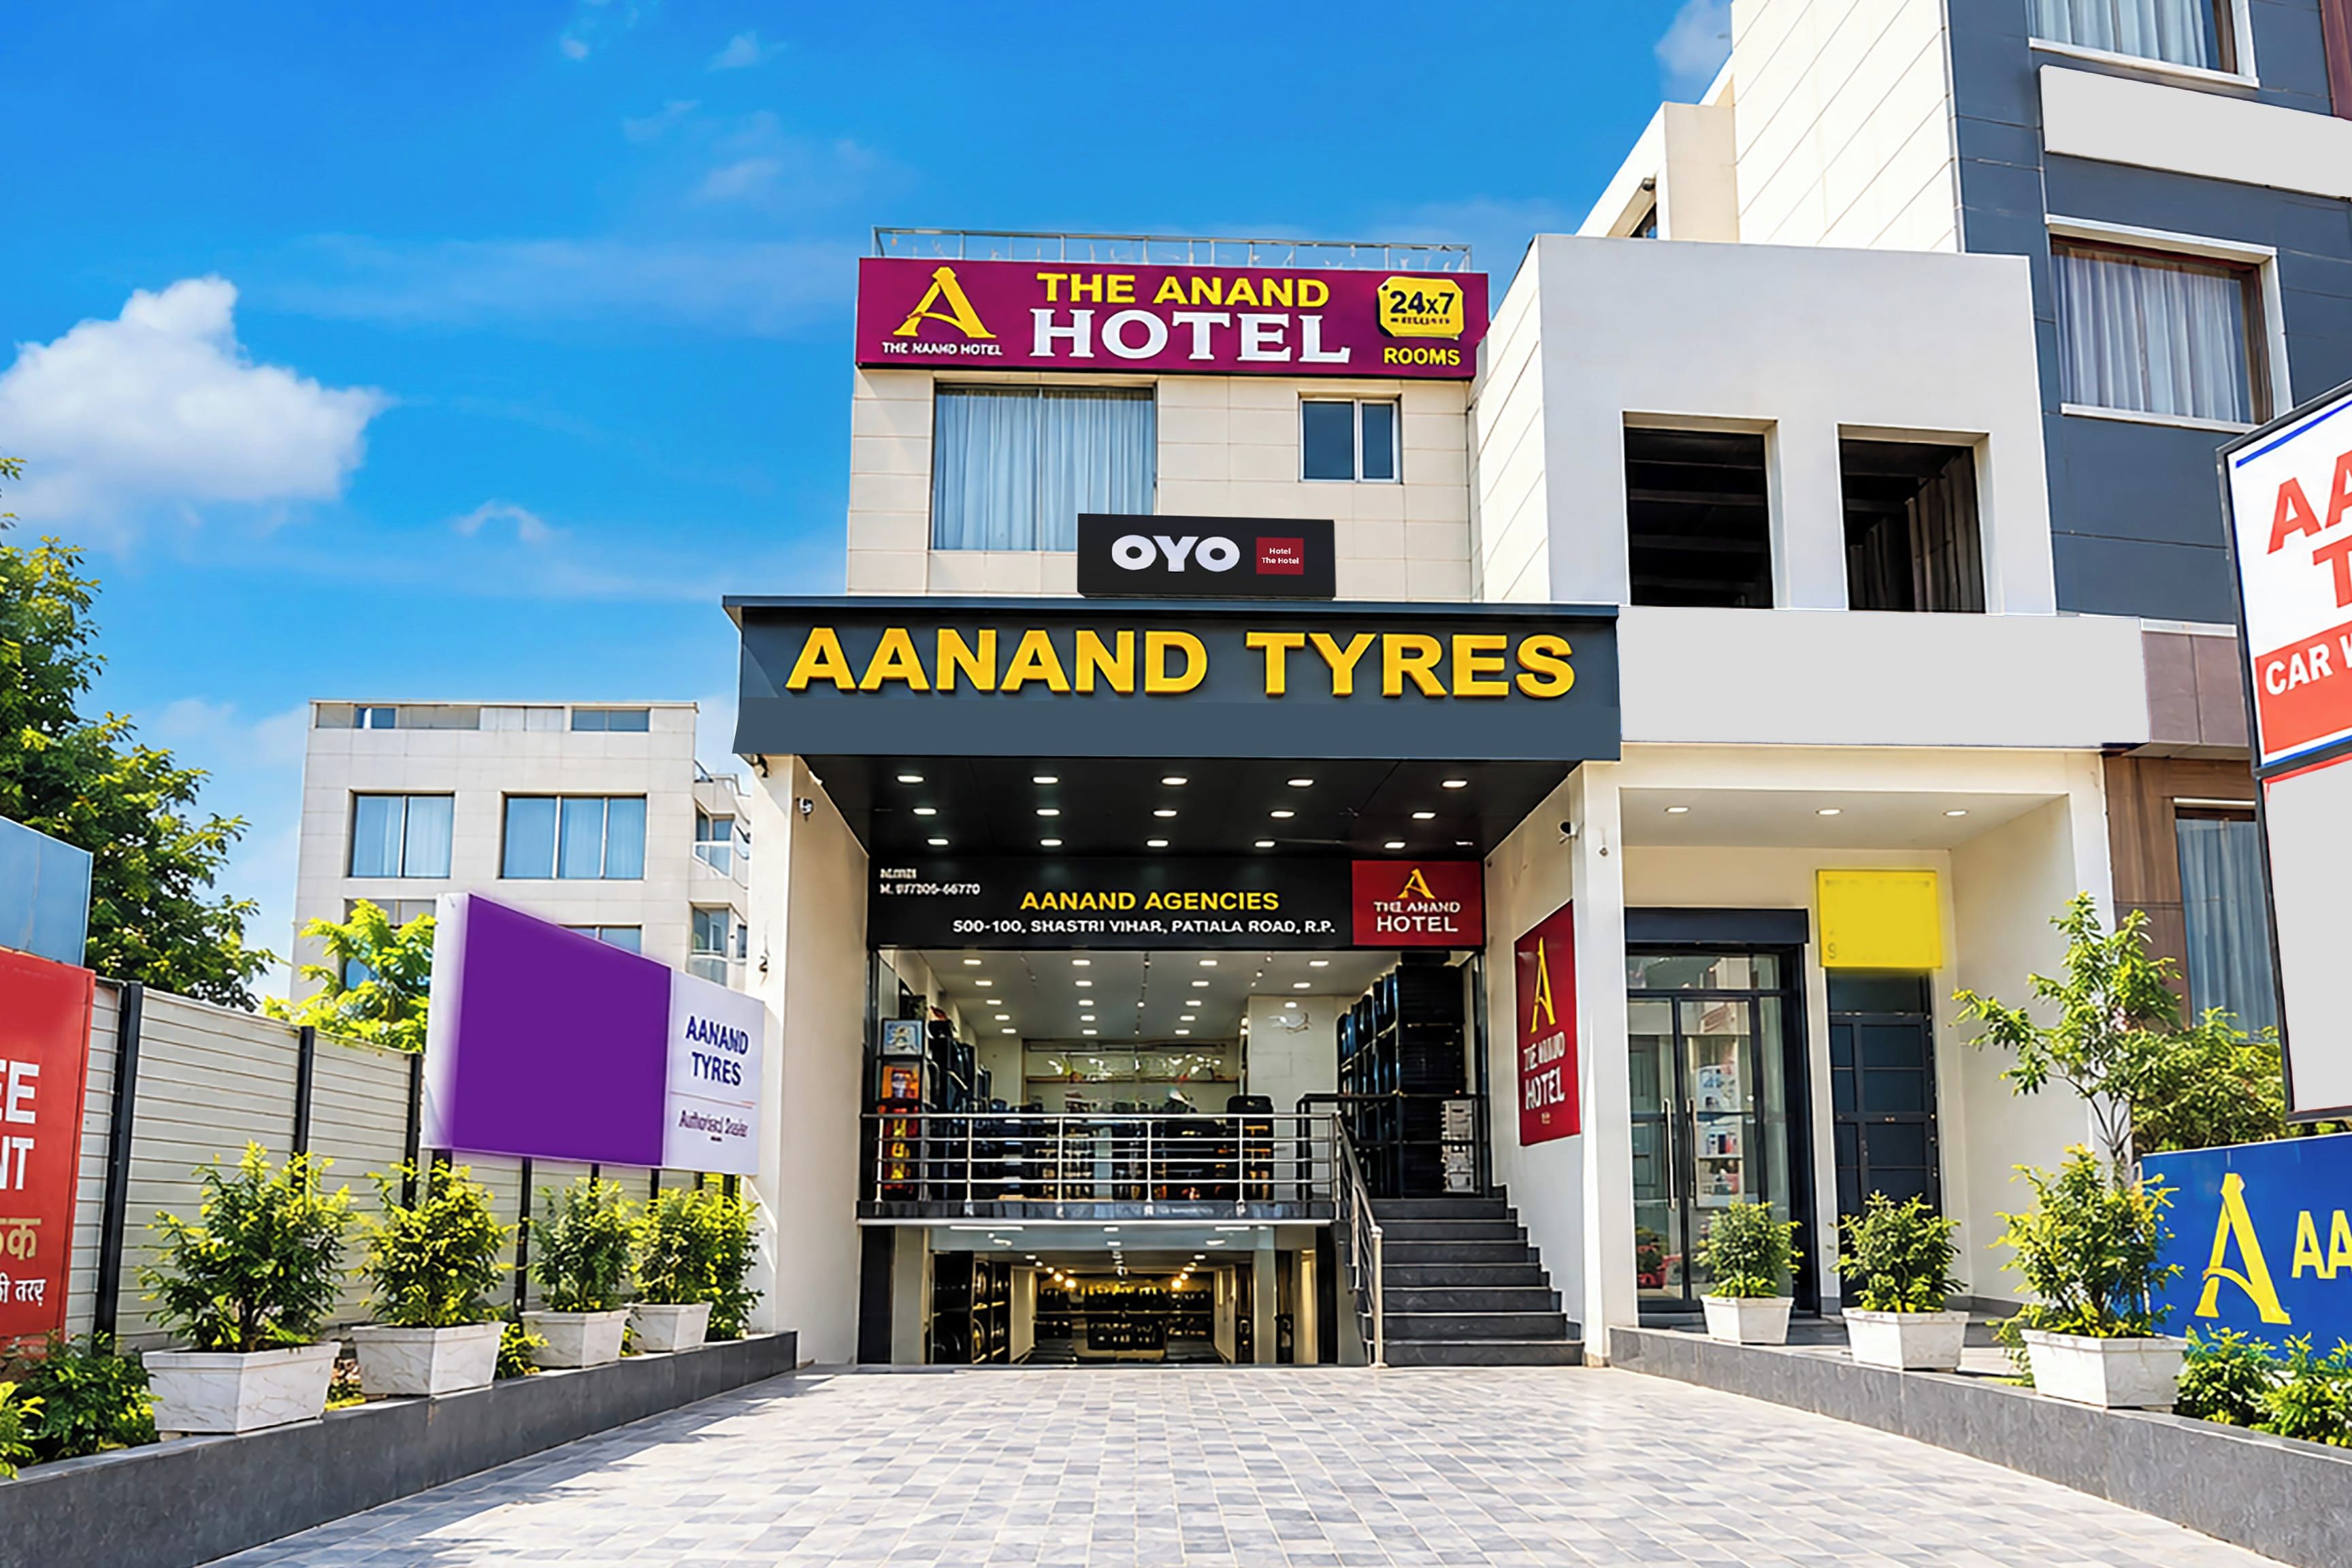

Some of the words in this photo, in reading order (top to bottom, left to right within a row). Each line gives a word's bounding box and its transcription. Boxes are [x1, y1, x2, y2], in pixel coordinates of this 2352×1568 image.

[1036, 272, 1136, 303] THE
[1153, 276, 1329, 307] ANAND
[1390, 291, 1455, 314] 24x7
[1030, 308, 1351, 363] HOTEL
[1384, 347, 1460, 366] ROOMS
[1111, 534, 1240, 572] OYO
[785, 627, 1209, 695] AANAND
[1245, 632, 1575, 698] TYRES
[2266, 643, 2332, 696] CAR
[1020, 892, 1136, 910] AANAND
[1144, 892, 1279, 910] AGENCIES
[1031, 919, 1105, 932] SHASTRI
[1172, 920, 1243, 932] PATIALA
[1377, 915, 1458, 932] HOTEL
[685, 1015, 749, 1056] AANAND
[691, 1051, 742, 1086] TYRES
[1525, 1066, 1565, 1111] HOTEL
